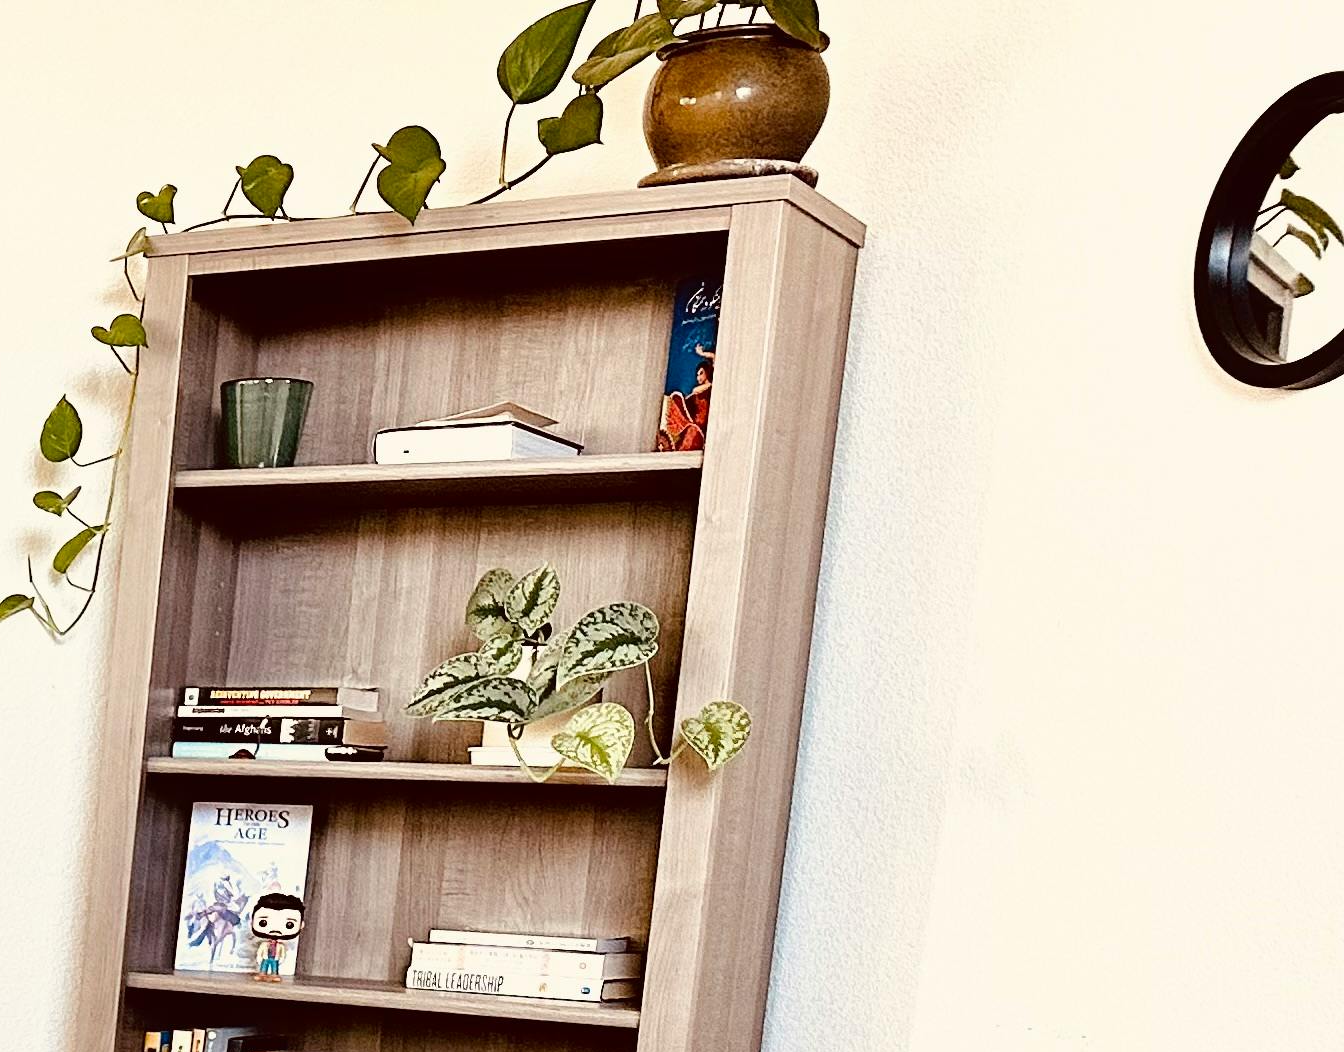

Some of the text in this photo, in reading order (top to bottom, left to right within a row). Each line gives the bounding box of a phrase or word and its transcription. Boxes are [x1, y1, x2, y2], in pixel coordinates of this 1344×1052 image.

[214, 807, 290, 829] HEROES
[234, 827, 268, 840] AGE
[412, 968, 505, 993] TRIBAL LEADERSHIP
